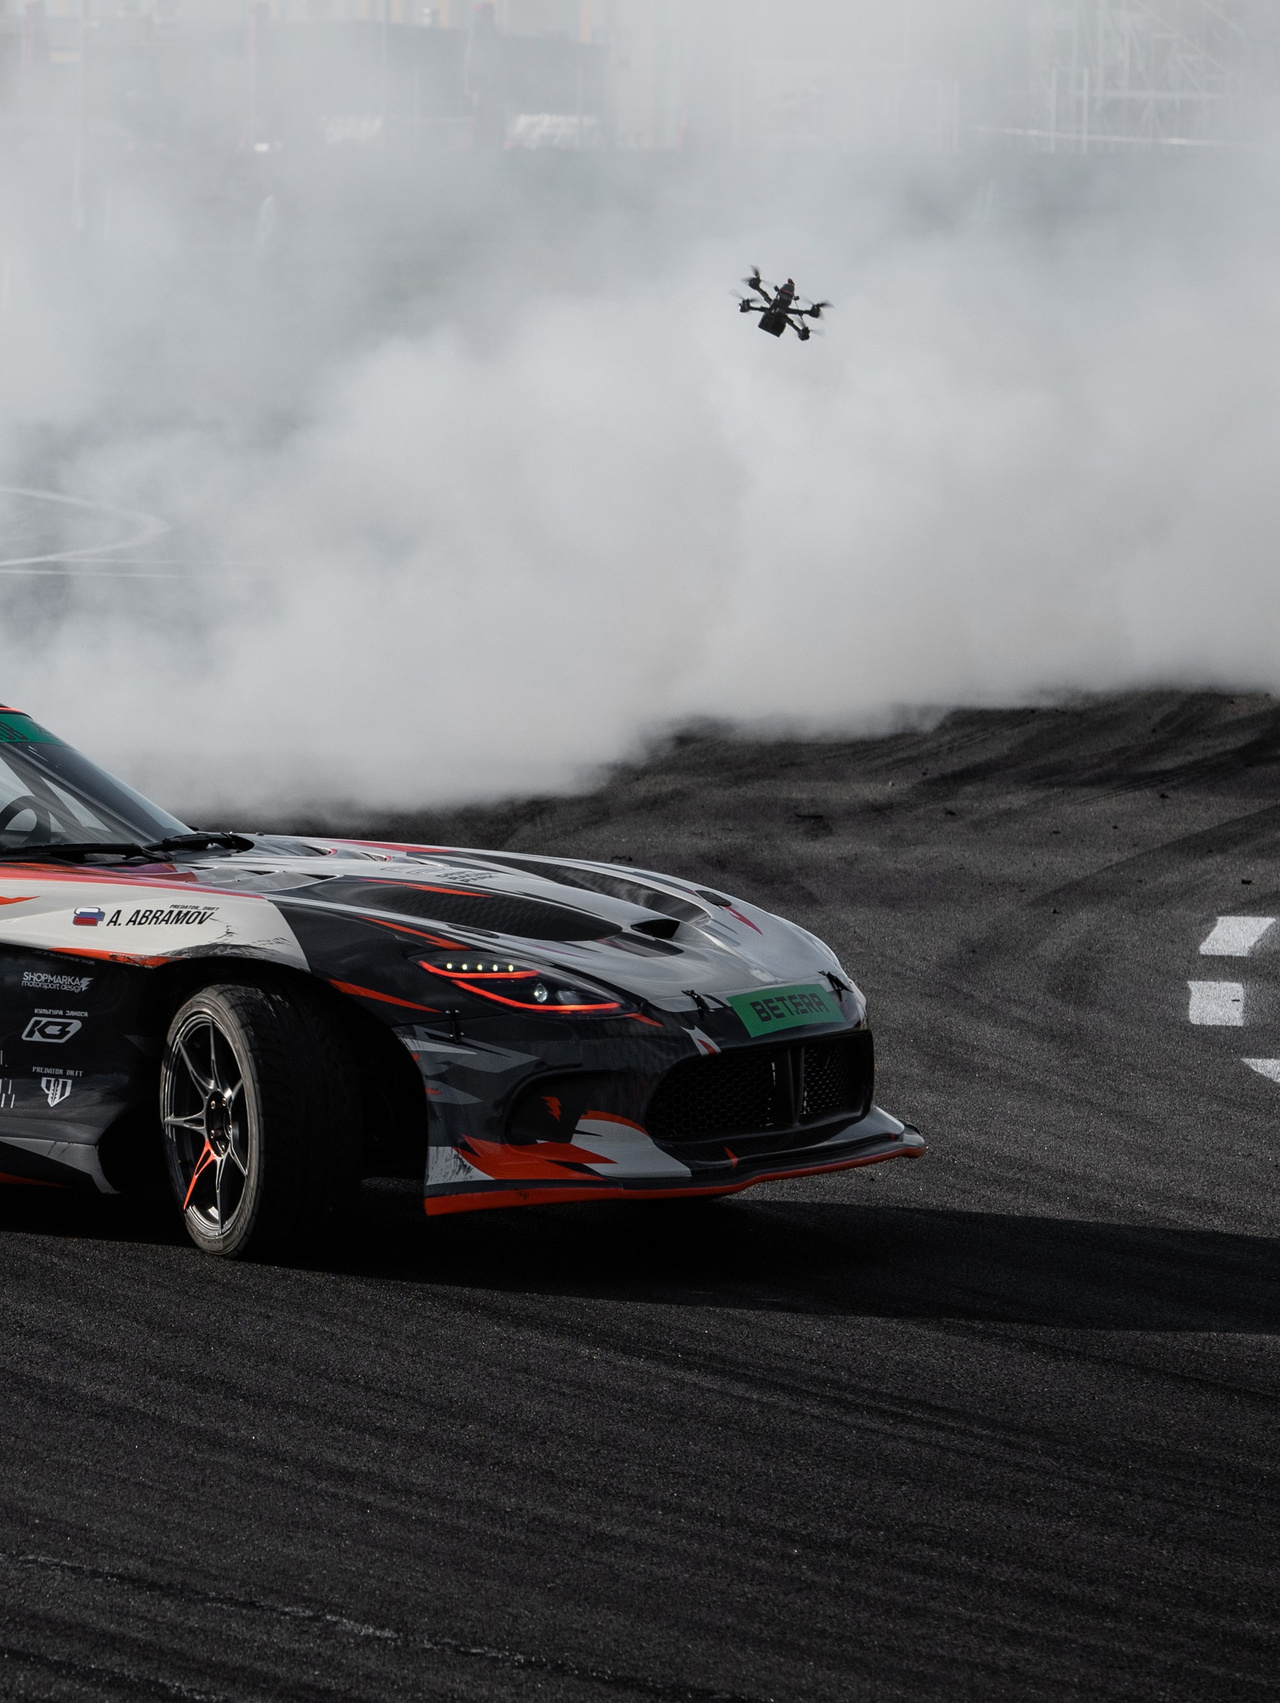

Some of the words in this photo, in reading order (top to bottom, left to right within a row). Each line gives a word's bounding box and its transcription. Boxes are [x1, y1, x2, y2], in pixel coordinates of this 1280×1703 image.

[106, 909, 123, 927] A.
[125, 909, 216, 926] ABRAMOV
[22, 971, 82, 986] SHOPMARKA
